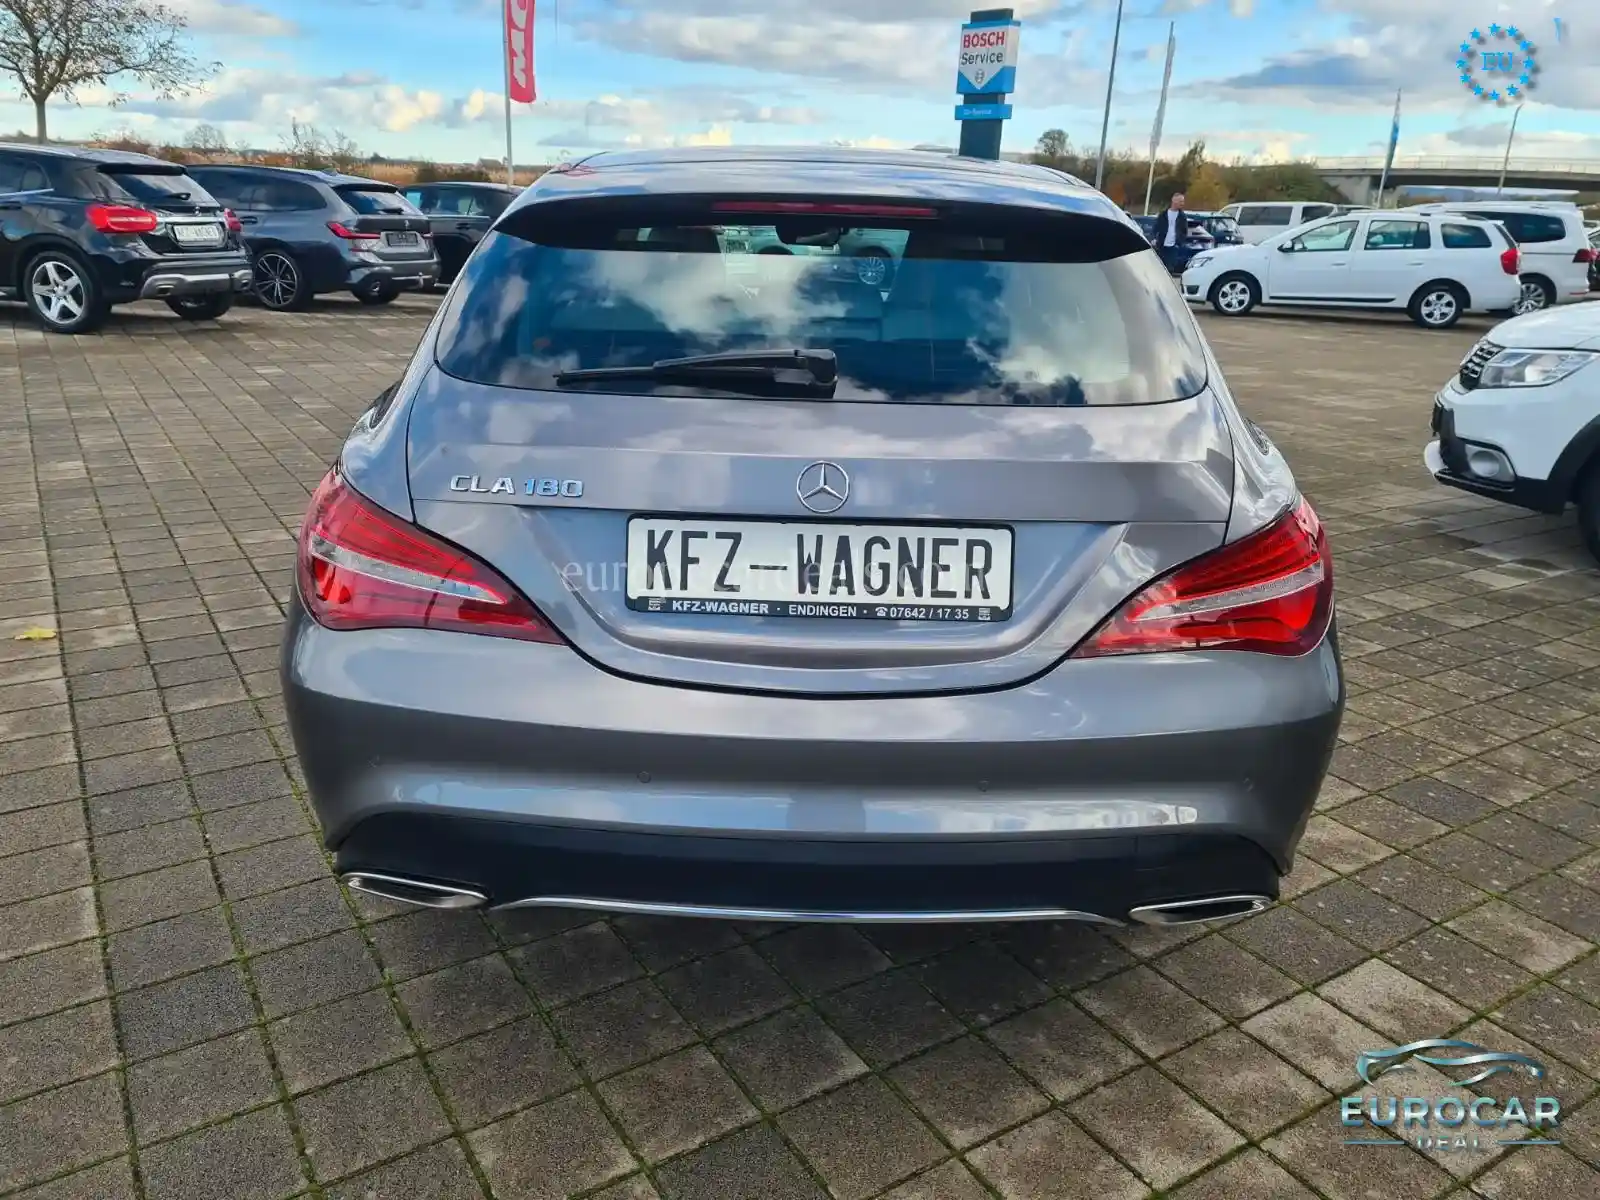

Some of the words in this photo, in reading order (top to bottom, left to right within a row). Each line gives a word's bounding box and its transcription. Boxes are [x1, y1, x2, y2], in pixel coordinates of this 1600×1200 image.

[963, 31, 1005, 48] BOSCH
[961, 52, 1004, 66] Service
[450, 475, 516, 494] CLA
[524, 478, 583, 497] 180
[672, 600, 769, 615] KFZ-WAGNER
[788, 604, 857, 617] ENDINGEN
[889, 607, 926, 619] 07642
